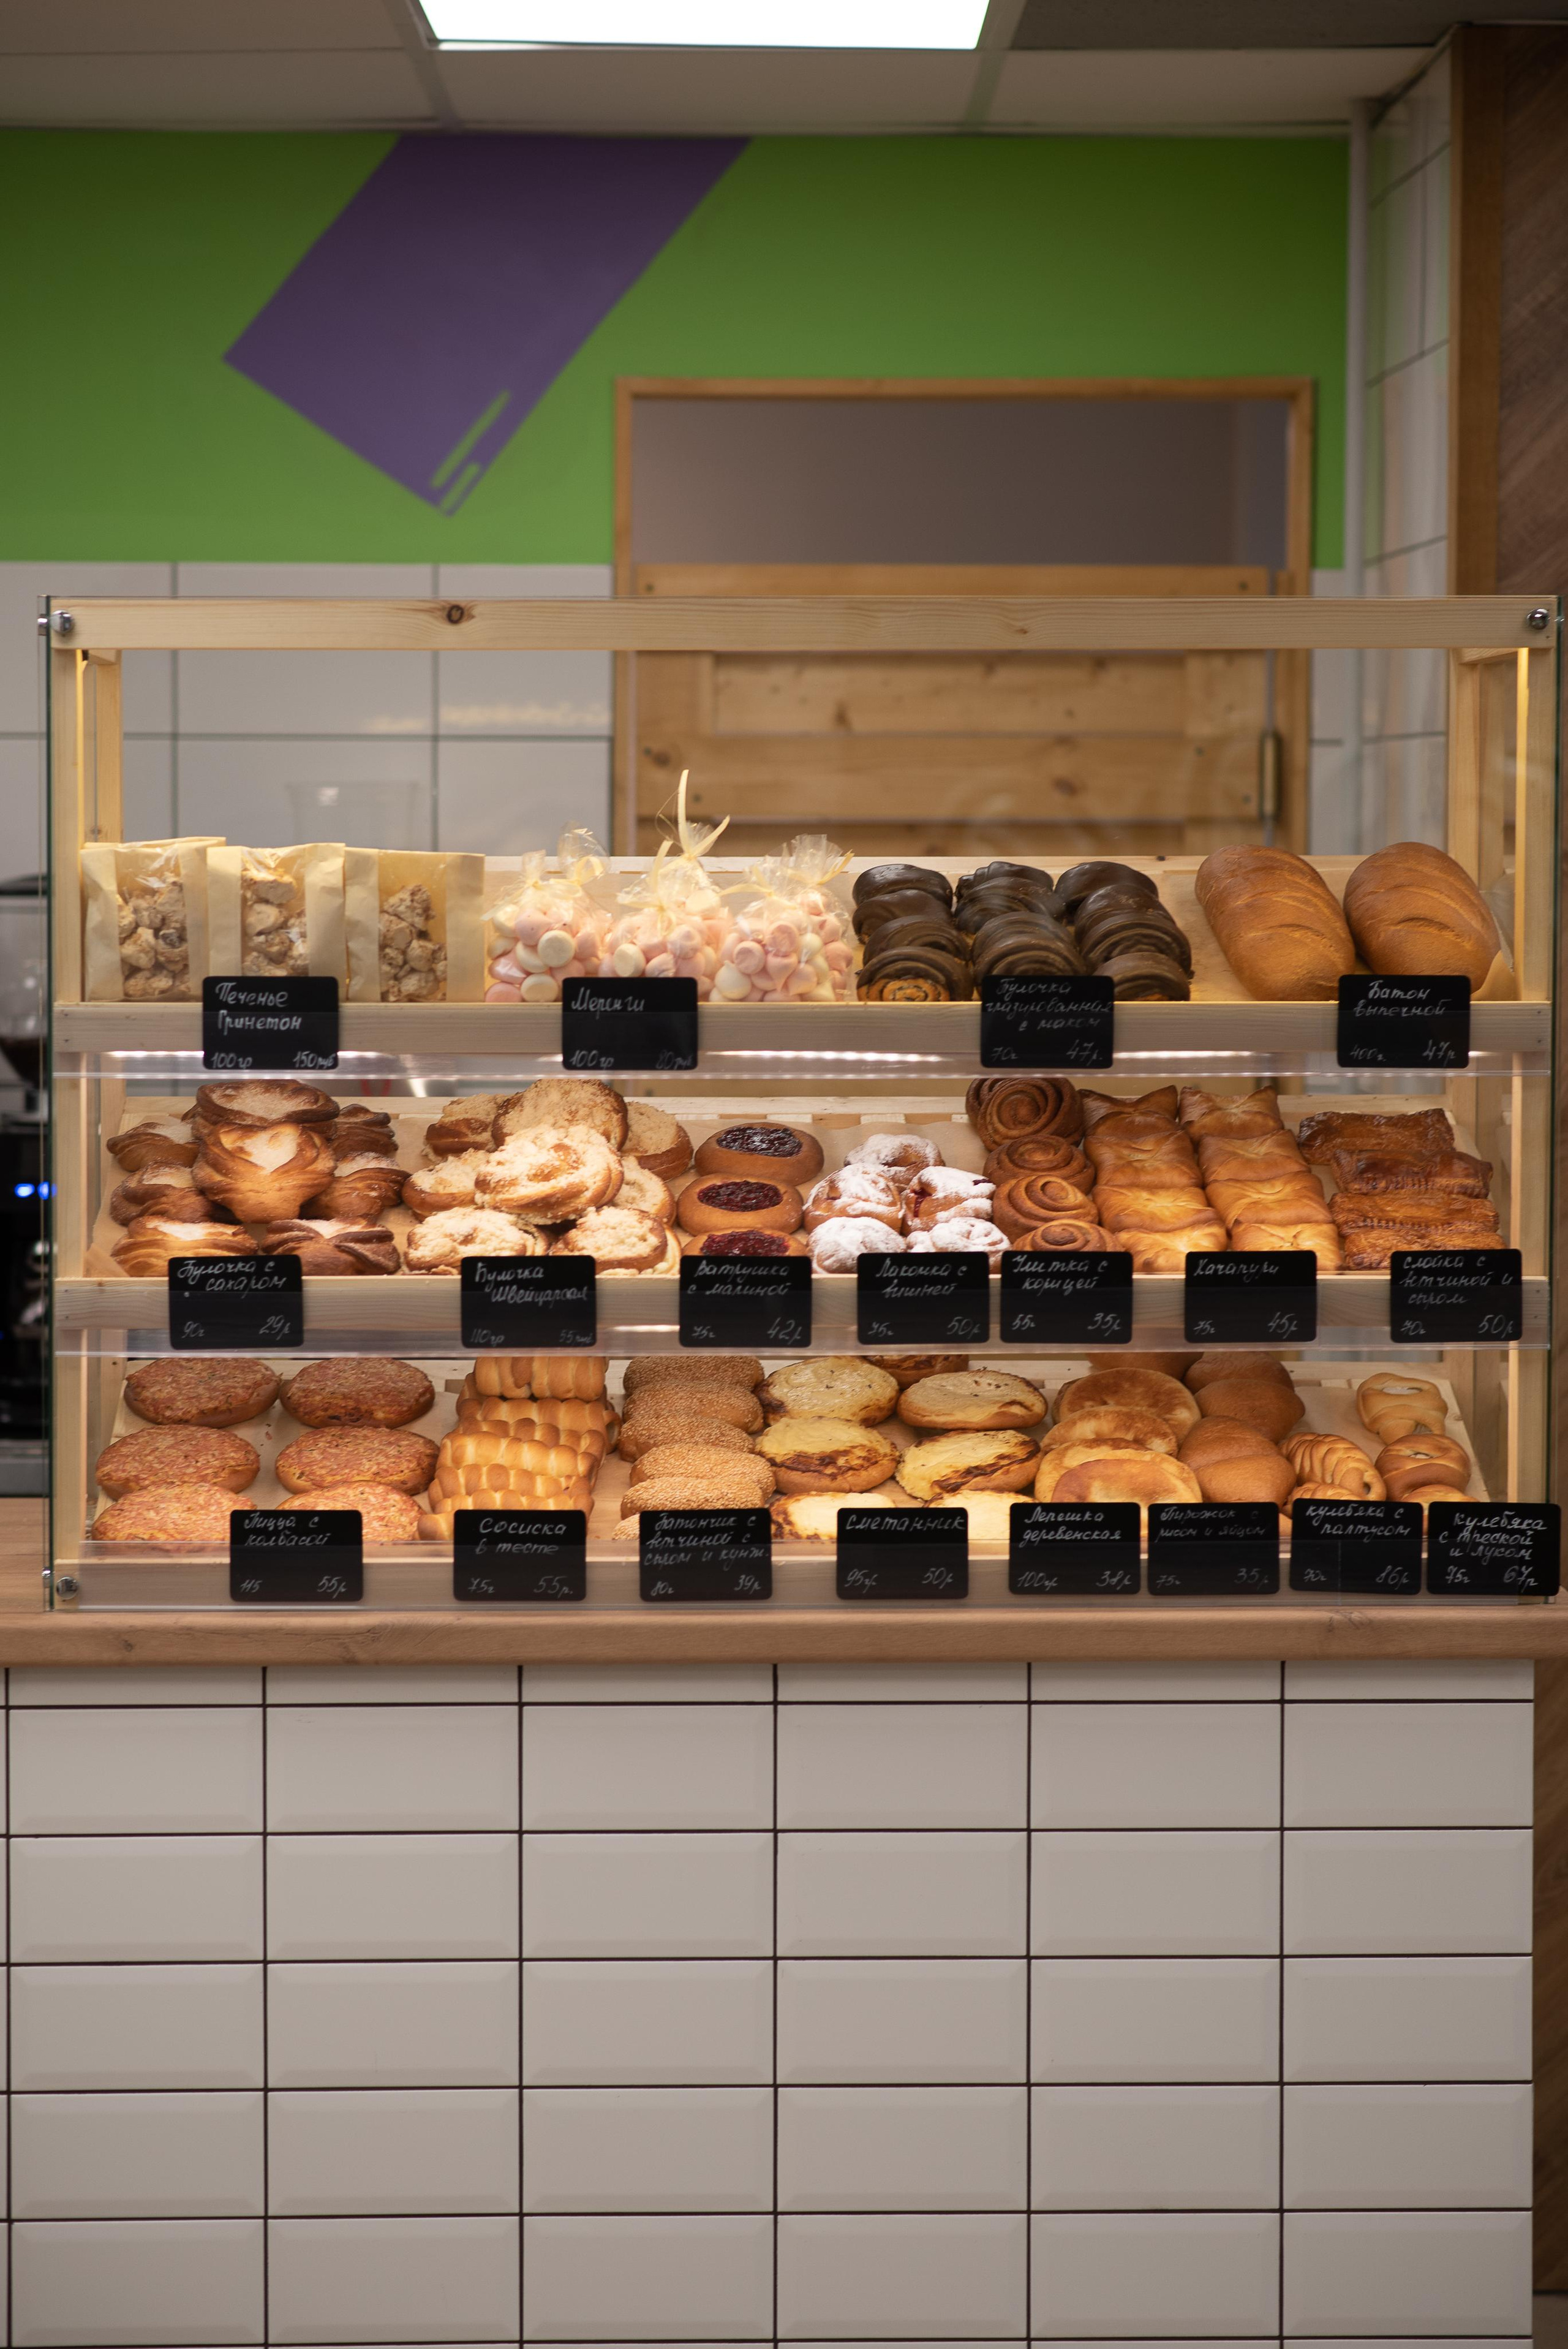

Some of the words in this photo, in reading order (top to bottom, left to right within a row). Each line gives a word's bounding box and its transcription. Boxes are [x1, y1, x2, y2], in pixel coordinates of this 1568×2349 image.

[215, 982, 289, 1007] Печенье
[996, 978, 1071, 1001] Булочка
[1368, 980, 1431, 1000] Батон
[217, 1010, 302, 1036] Гринетон
[1037, 1018, 1101, 1030] маком
[177, 1260, 257, 1285] Булочка
[694, 1259, 790, 1283] Ватрушка
[875, 1257, 952, 1277] Лакомка
[1012, 1254, 1090, 1273] Улитка
[1193, 1258, 1280, 1283] Хачапури
[475, 1262, 545, 1293] Булочка
[1021, 1276, 1099, 1296] корицей
[1501, 1273, 1513, 1285] и
[205, 1276, 287, 1299] сахаром
[704, 1282, 792, 1296] малиной
[1408, 1292, 1469, 1309] сыром
[654, 1512, 738, 1530] Батончик
[845, 1515, 965, 1531] Сметанник
[1024, 1505, 1104, 1523] Лепешка
[1161, 1506, 1237, 1524] Пирожок
[480, 1518, 567, 1535] Сосиска
[1154, 1528, 1197, 1543] рисом
[1321, 1524, 1411, 1543] палтусом
[244, 1530, 331, 1546] колбасой
[1019, 1526, 1121, 1548] деревенская
[1457, 1530, 1534, 1553] треской
[496, 1543, 559, 1554] тесте
[1449, 1548, 1463, 1556] и
[1471, 1545, 1532, 1565] луком
[644, 1553, 692, 1570] сыром
[701, 1551, 714, 1561] и
